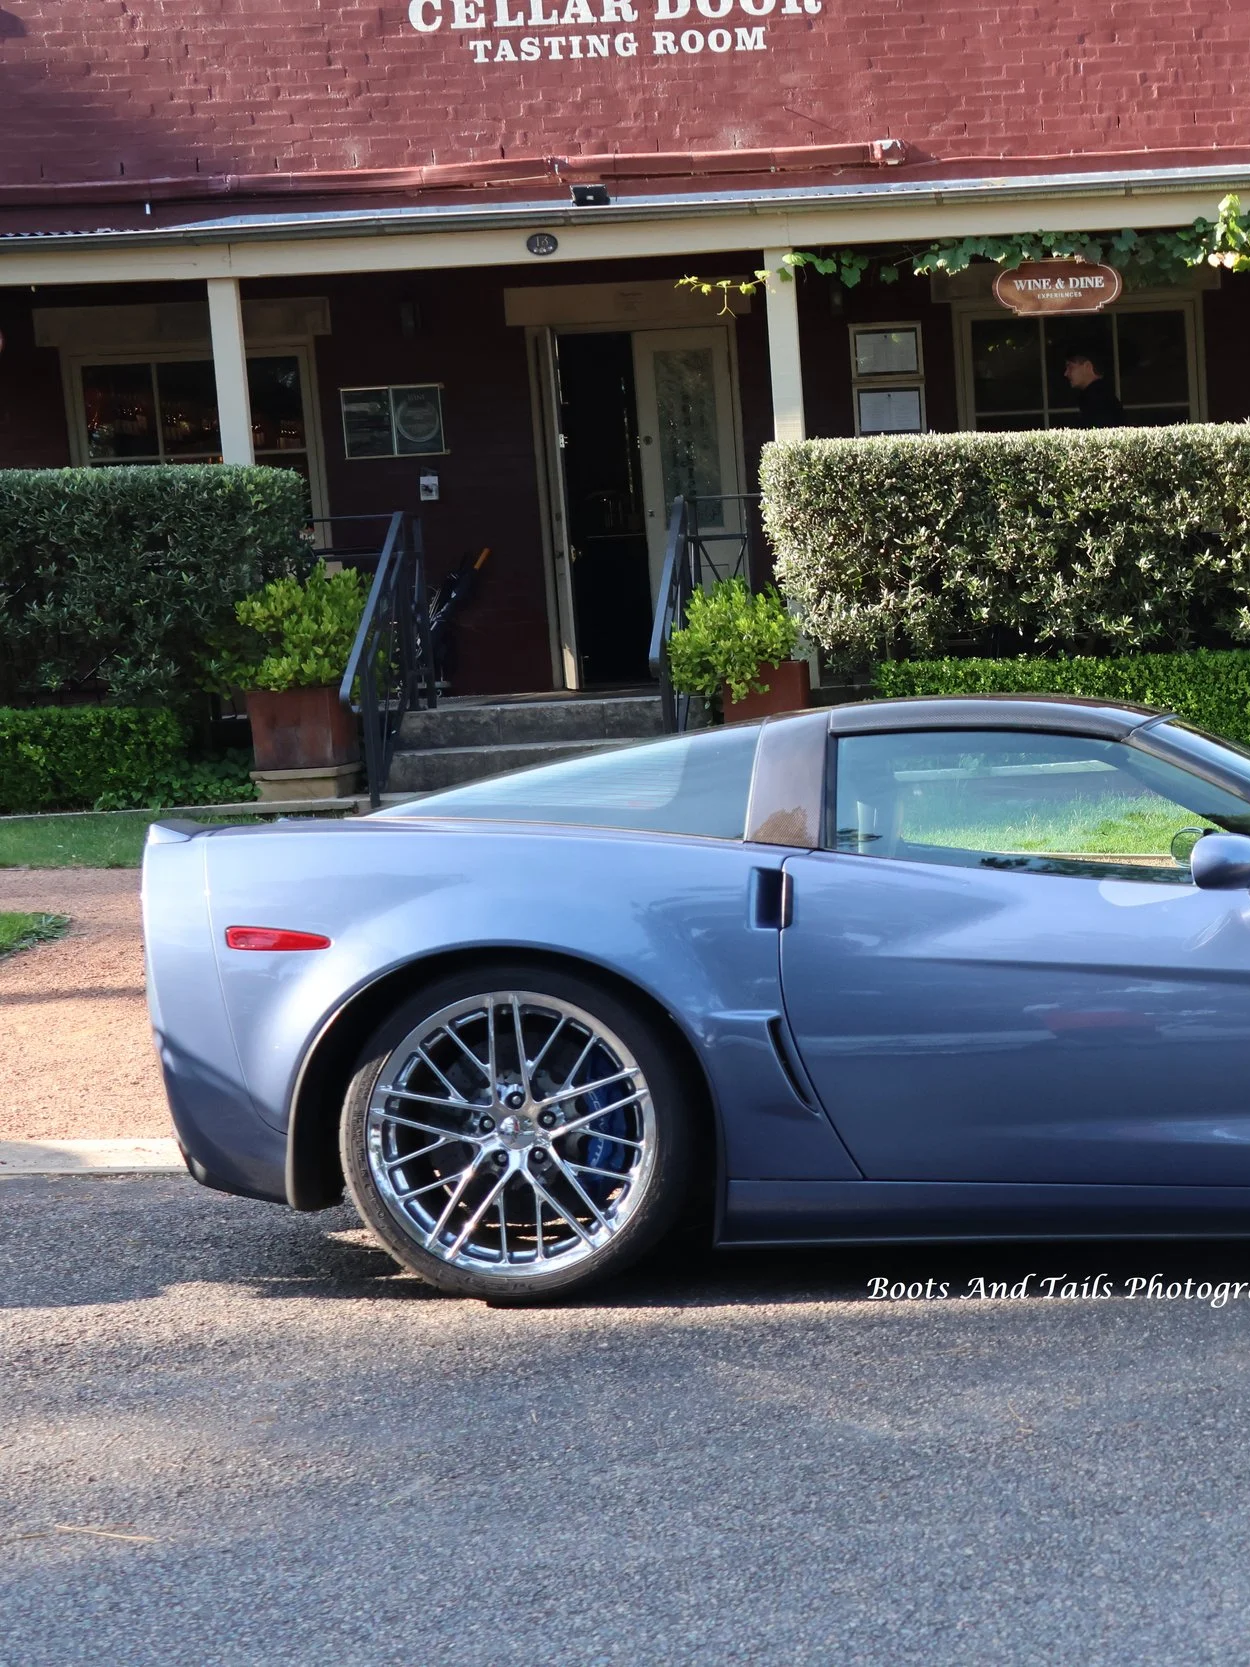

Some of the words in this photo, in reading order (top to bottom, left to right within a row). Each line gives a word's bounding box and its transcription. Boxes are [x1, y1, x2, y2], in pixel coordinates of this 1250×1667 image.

[408, 0, 638, 32] CELLAR
[469, 32, 638, 63] TASTING
[652, 26, 767, 55] ROOM
[1013, 278, 1052, 291] WINE
[1055, 278, 1065, 290] &
[1068, 276, 1105, 289] DINE
[1037, 291, 1082, 299] EXPERIENCES
